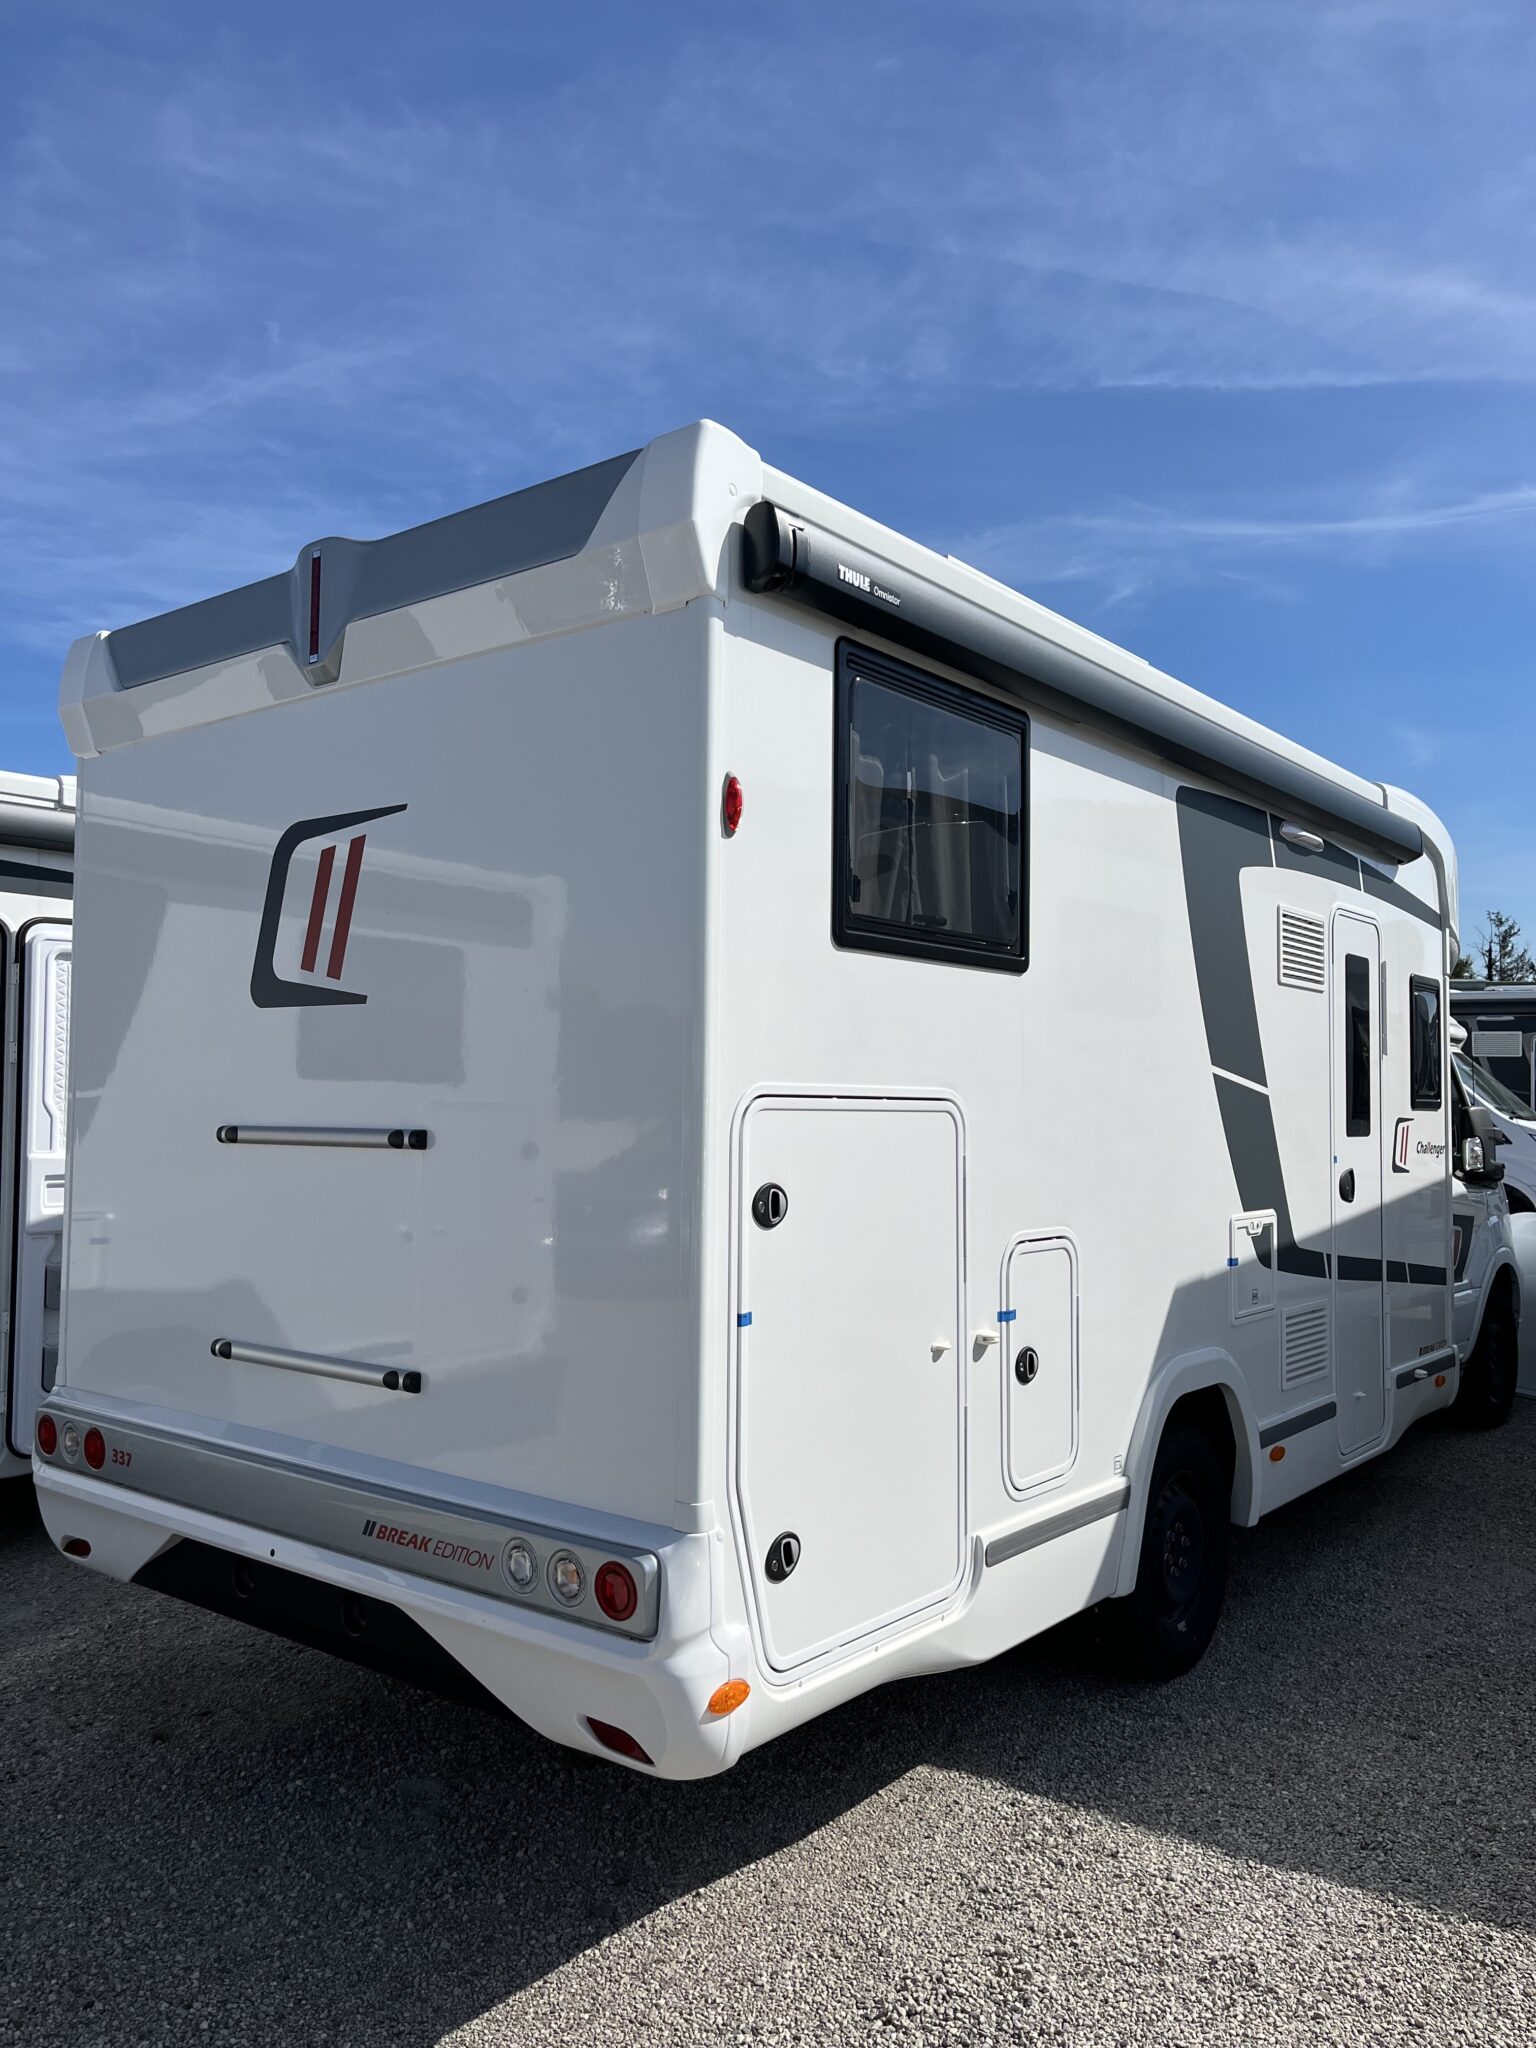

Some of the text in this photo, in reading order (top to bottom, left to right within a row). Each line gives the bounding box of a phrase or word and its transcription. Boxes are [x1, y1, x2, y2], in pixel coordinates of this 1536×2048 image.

[837, 563, 901, 606] THULE Omnistor
[1416, 1141, 1446, 1158] Challenger
[112, 1448, 132, 1467] 337
[376, 1524, 495, 1570] BREAK EDITION
